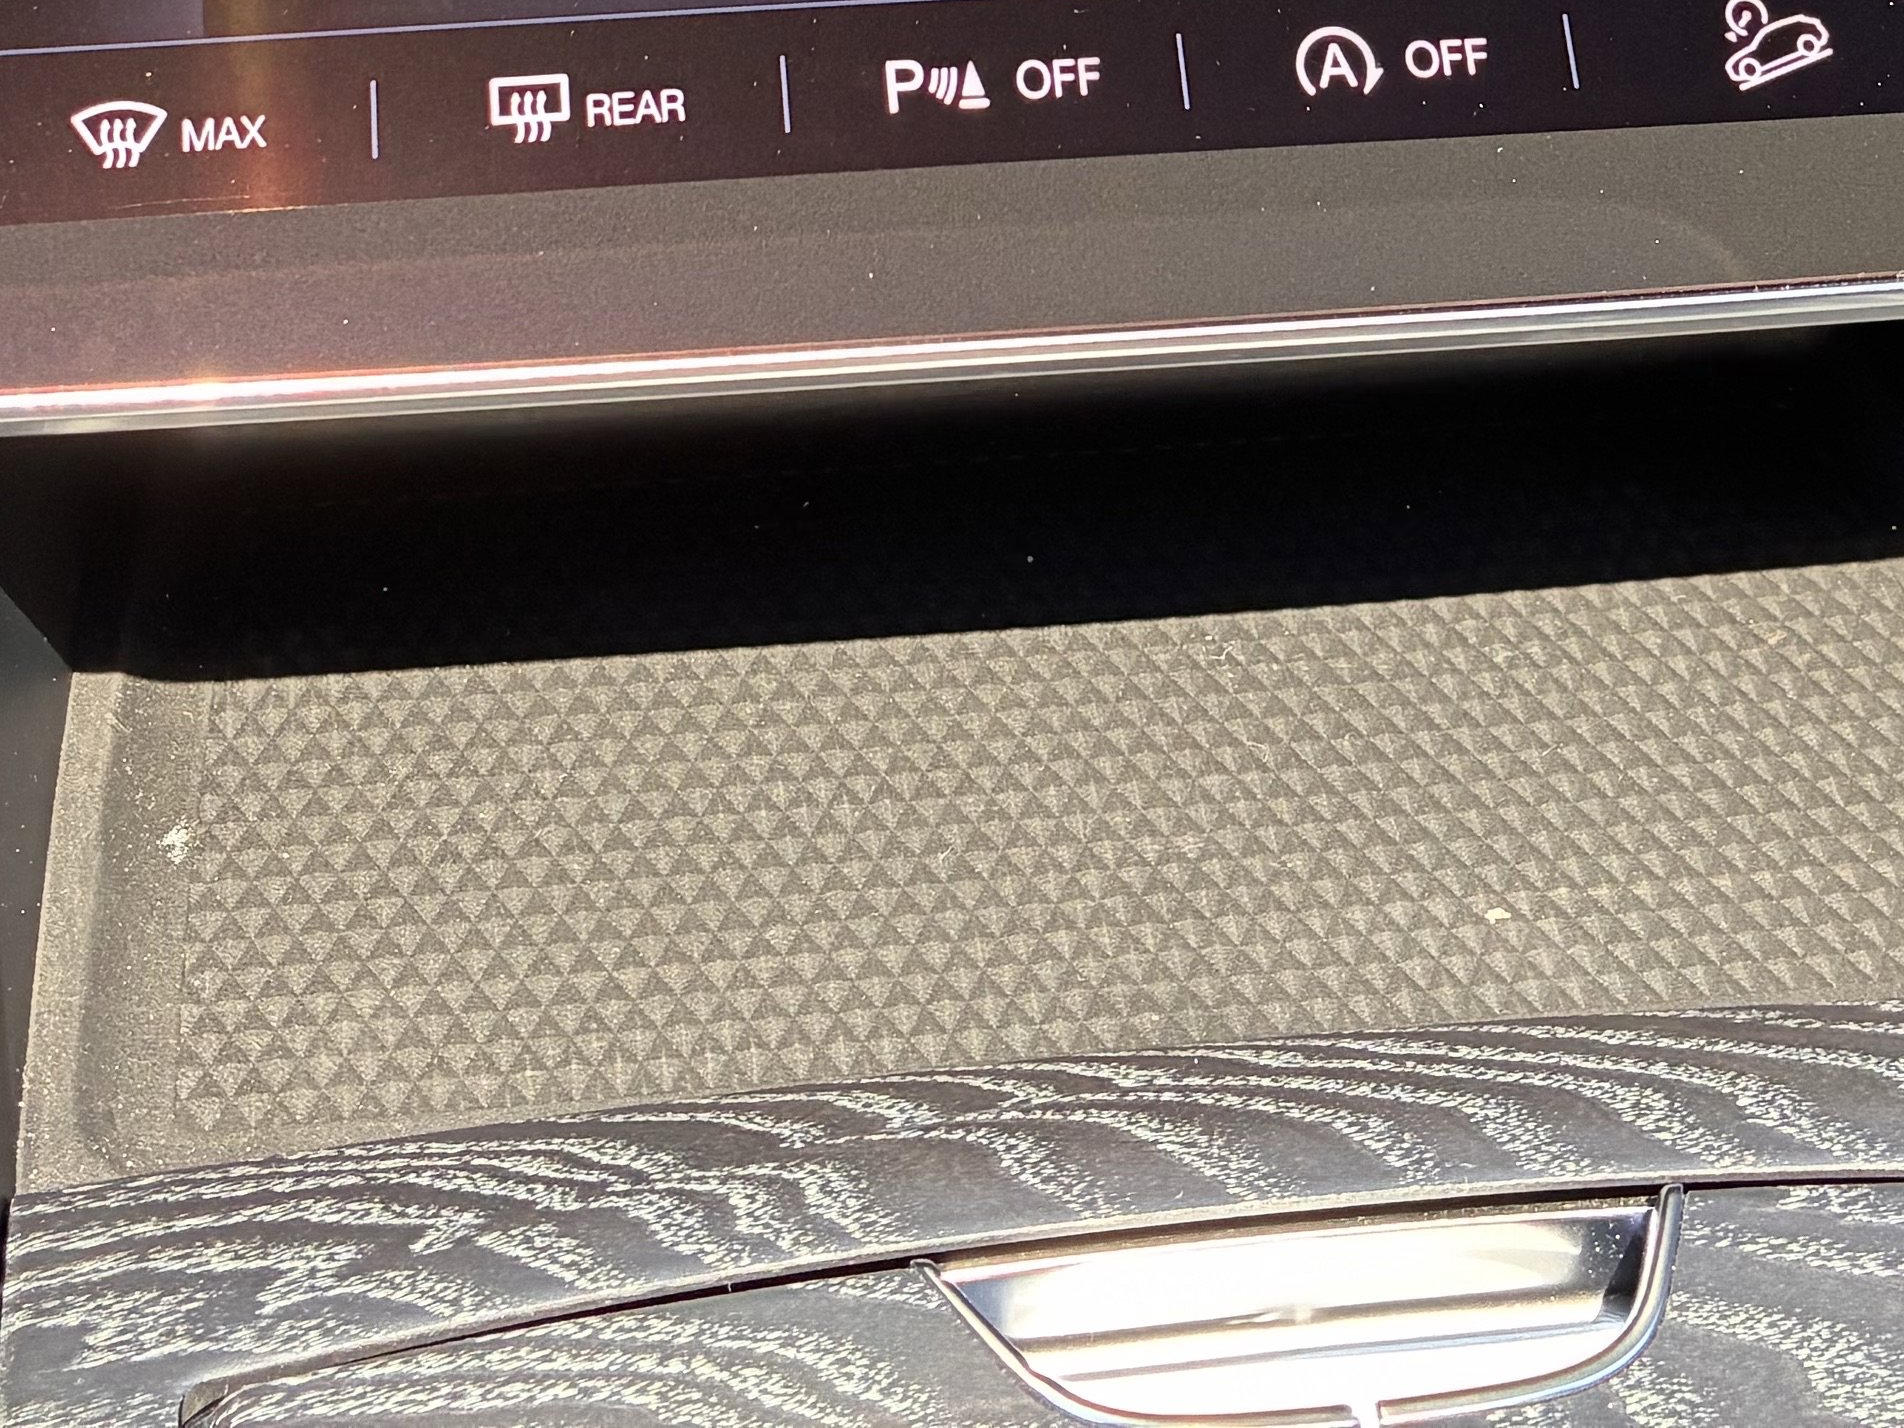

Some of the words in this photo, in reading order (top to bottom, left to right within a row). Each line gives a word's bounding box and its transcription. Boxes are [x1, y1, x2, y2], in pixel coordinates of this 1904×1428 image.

[1015, 56, 1101, 100] OFF
[1404, 37, 1488, 79] OFF
[585, 88, 686, 128] REAR
[181, 114, 268, 153] MAX
